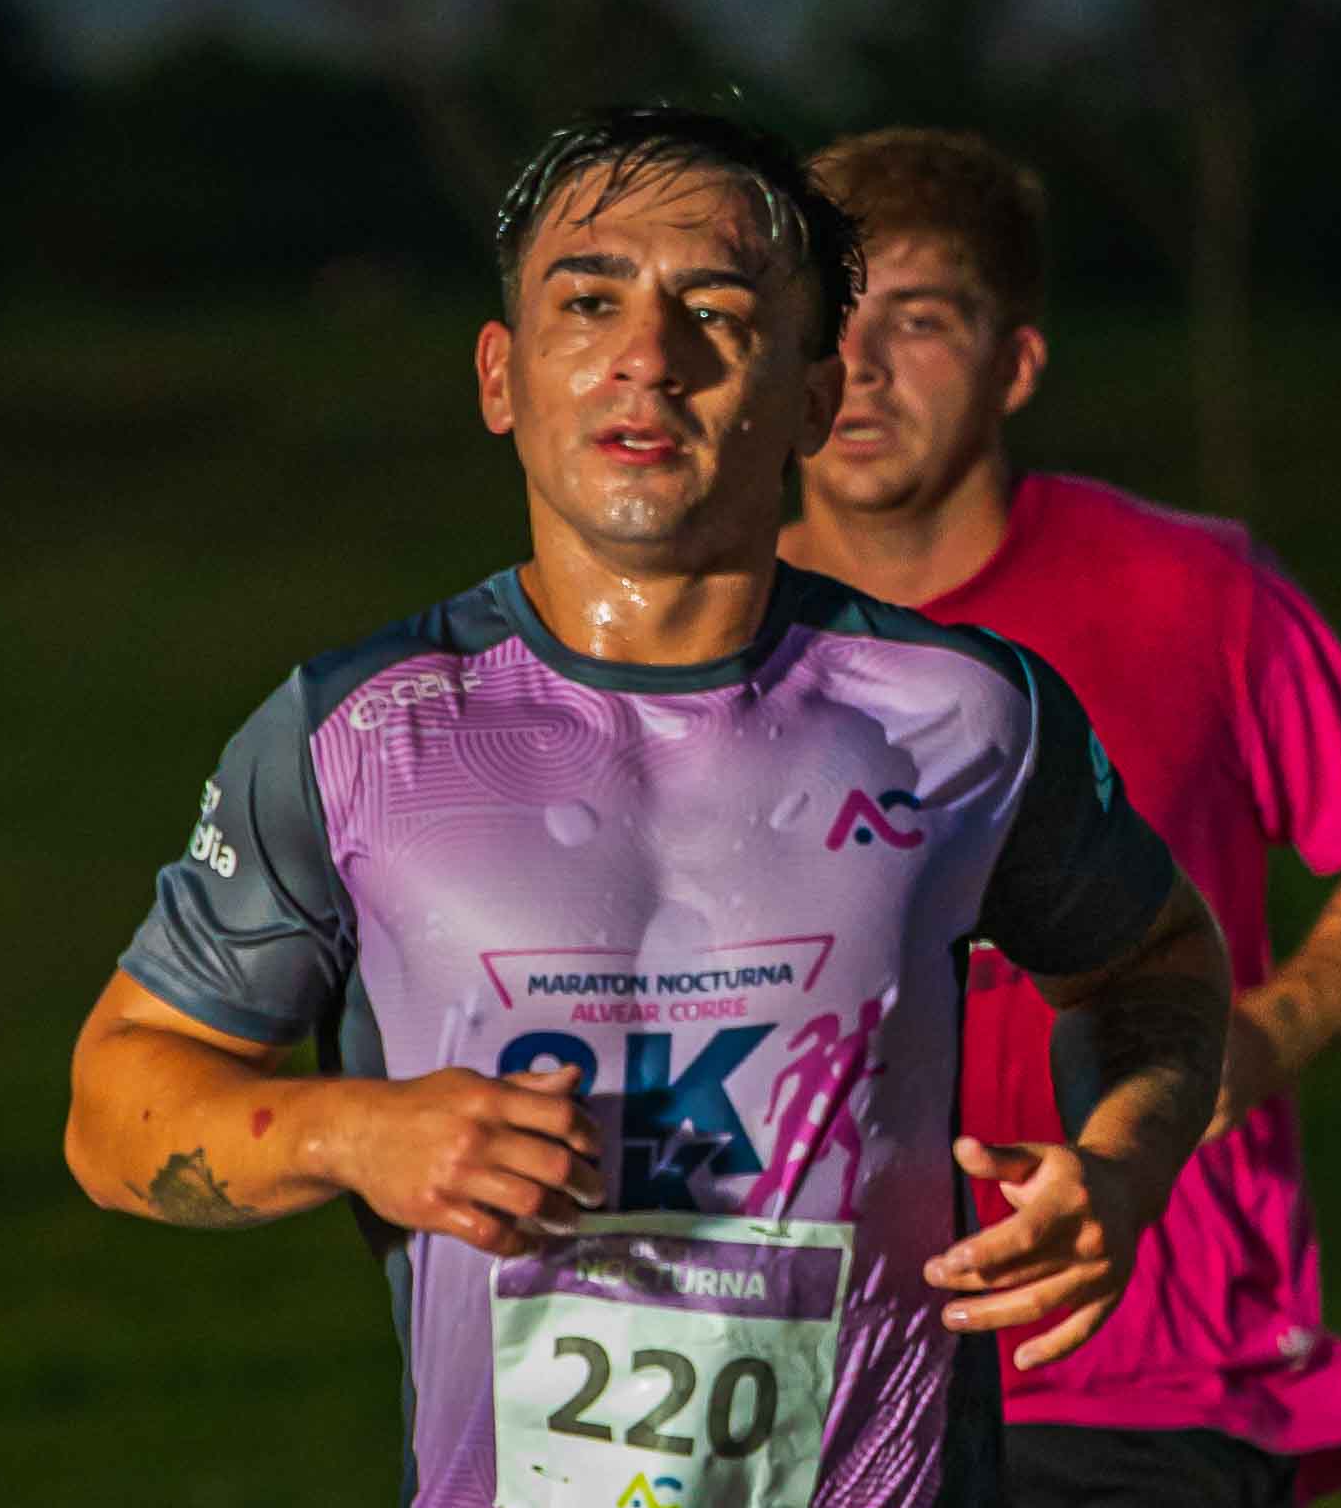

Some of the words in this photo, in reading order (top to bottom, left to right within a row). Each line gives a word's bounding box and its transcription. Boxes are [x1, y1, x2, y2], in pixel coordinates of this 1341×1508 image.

[528, 973, 647, 996] MARATON
[657, 963, 794, 994] NOCTURNA
[571, 1002, 660, 1024] ALVEAR
[669, 997, 749, 1022] CORRE
[576, 1256, 767, 1300] NURNA
[548, 1336, 778, 1458] 220
